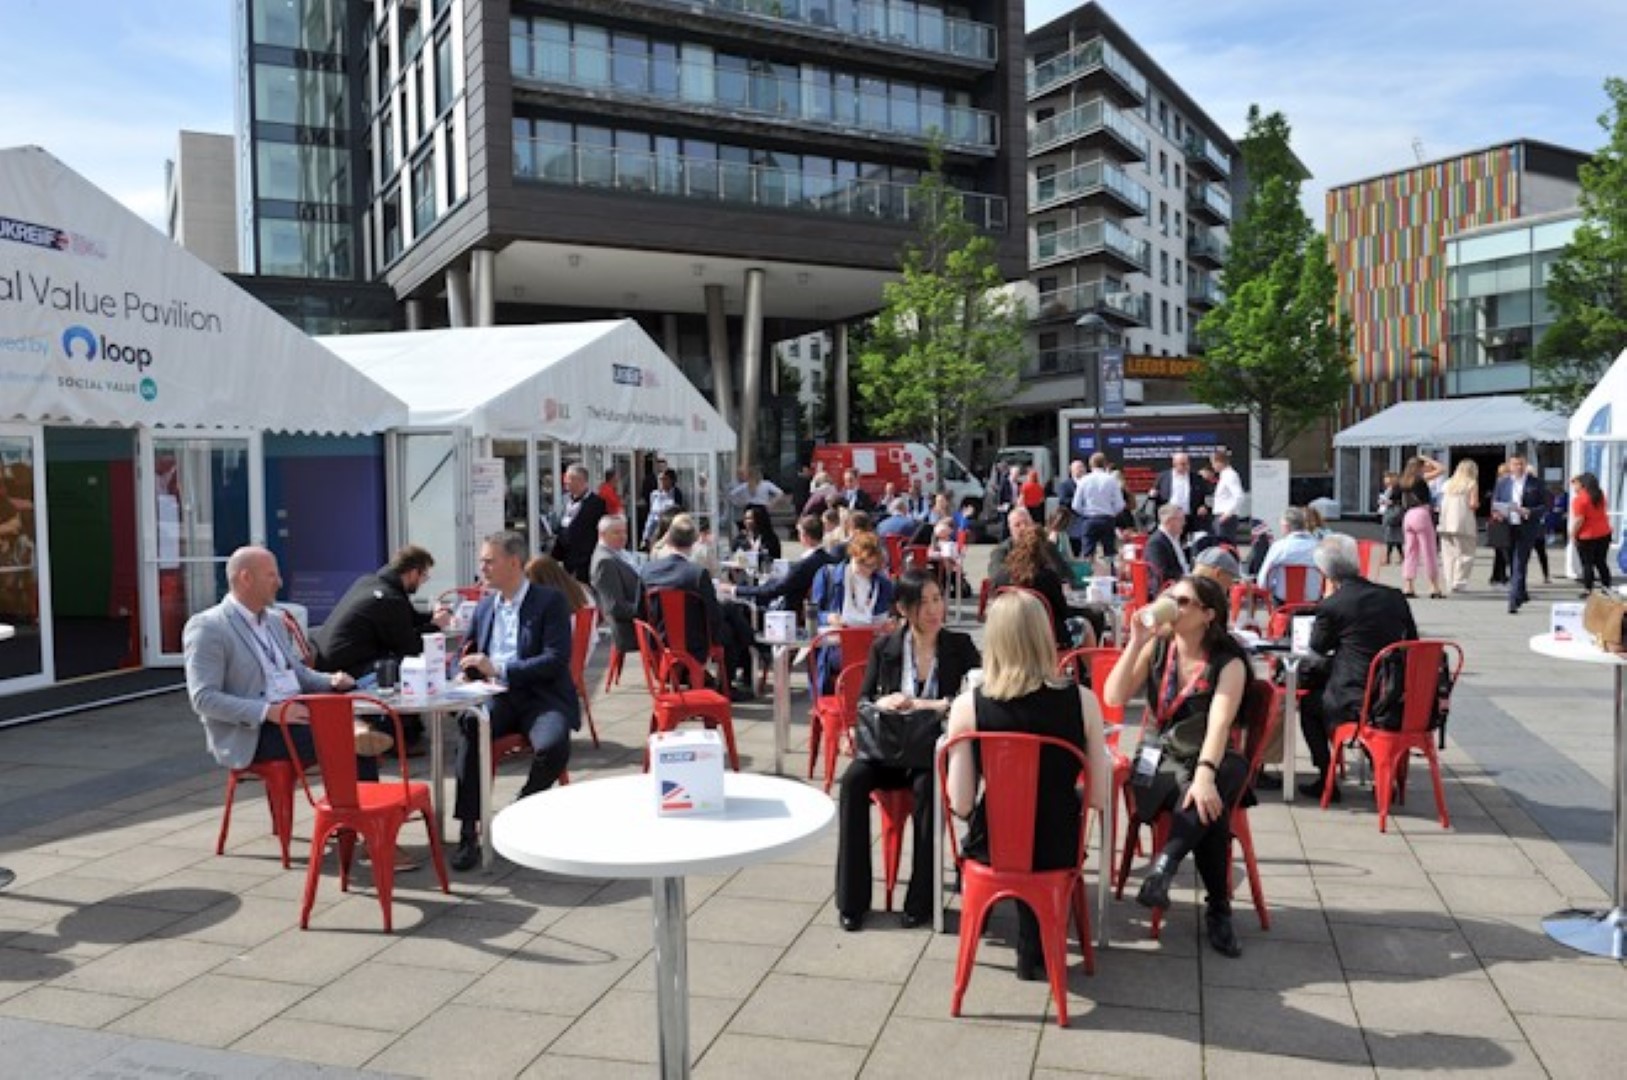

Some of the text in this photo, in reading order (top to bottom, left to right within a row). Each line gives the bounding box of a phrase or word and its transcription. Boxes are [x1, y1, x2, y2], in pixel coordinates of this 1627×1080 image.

[29, 271, 117, 318] Value
[124, 291, 222, 332] Pavilion
[100, 334, 152, 372] loop
[1127, 358, 1167, 375] LEEDS
[58, 376, 103, 391] SOCIAL
[106, 380, 137, 394] VALUE
